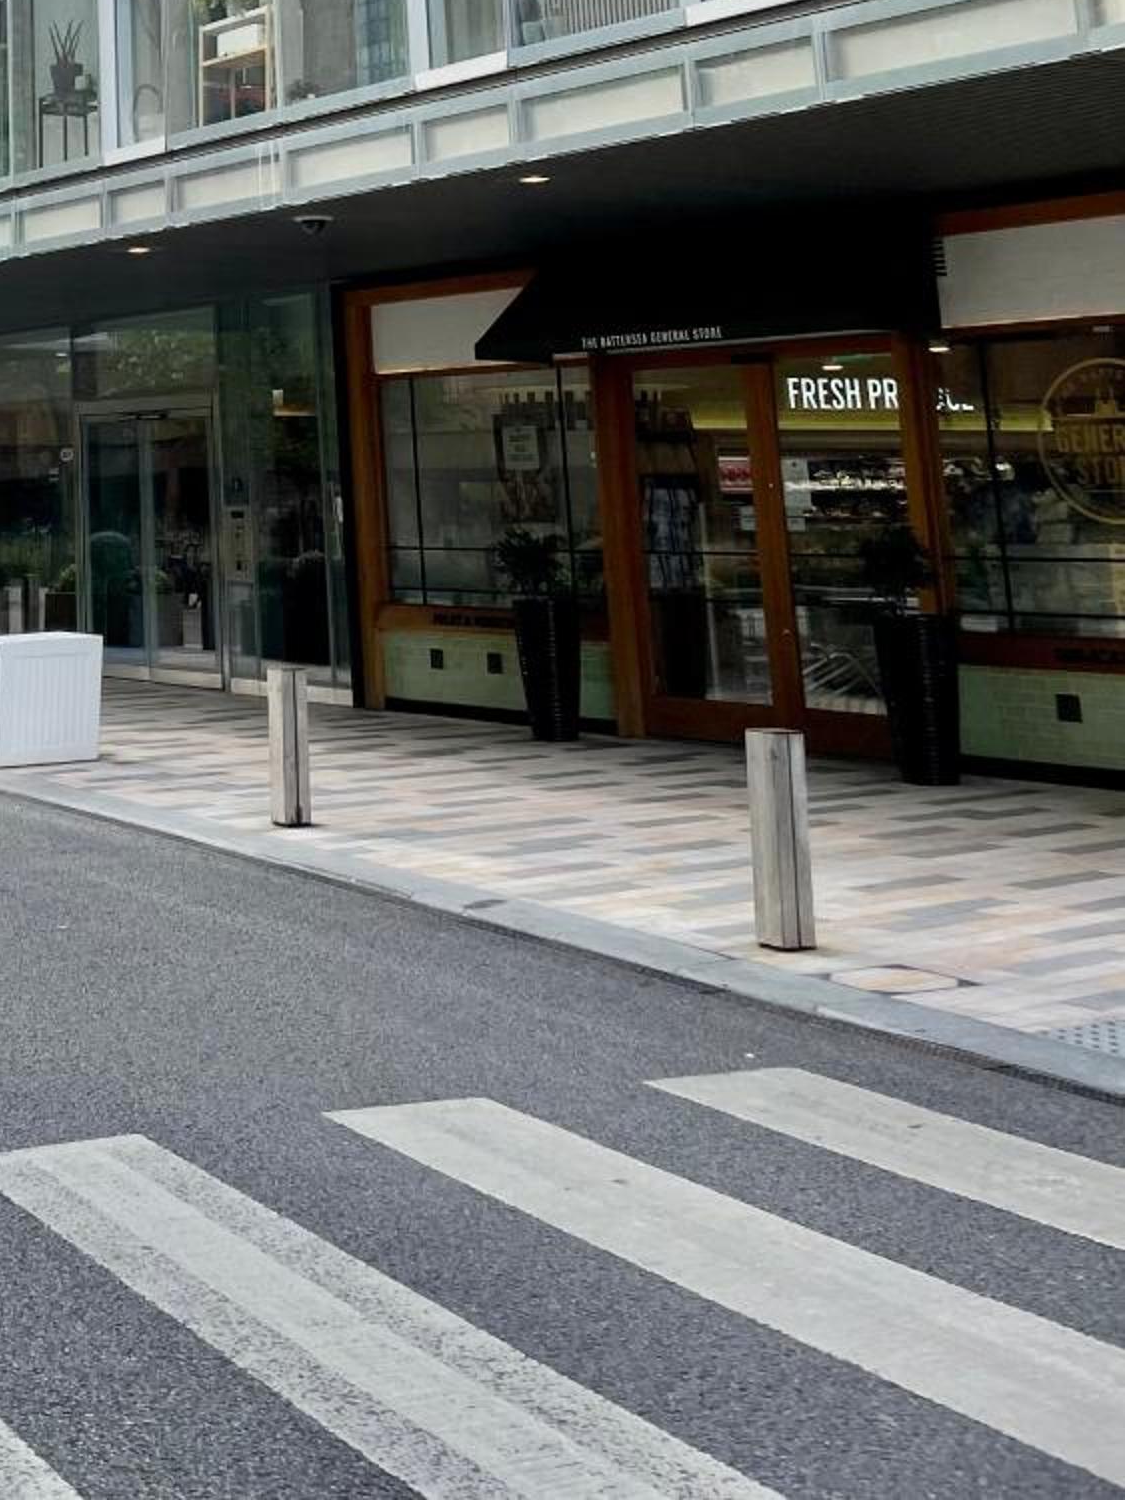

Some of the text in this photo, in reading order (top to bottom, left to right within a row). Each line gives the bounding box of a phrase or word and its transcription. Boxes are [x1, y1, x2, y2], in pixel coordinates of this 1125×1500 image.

[581, 326, 722, 349] THE BATTERSEA GENERAL STORE
[786, 377, 860, 409] FRESH
